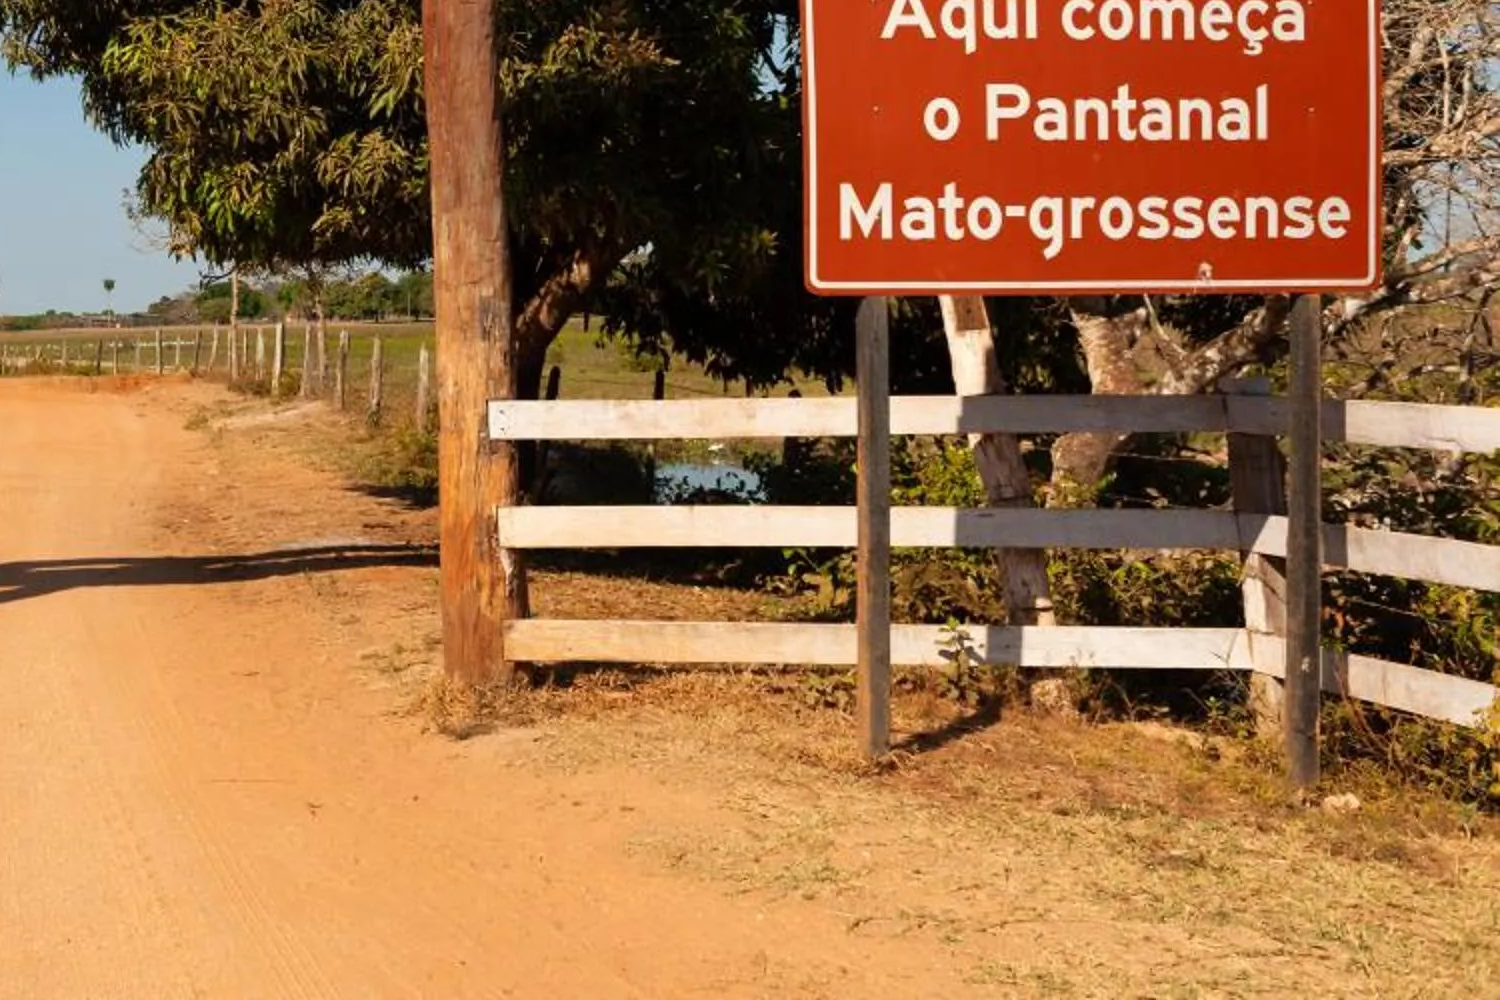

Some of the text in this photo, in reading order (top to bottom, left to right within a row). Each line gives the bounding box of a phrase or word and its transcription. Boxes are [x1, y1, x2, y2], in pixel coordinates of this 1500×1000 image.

[923, 83, 1268, 141] o Pantanal
[839, 182, 1351, 260] Mato-grossense
